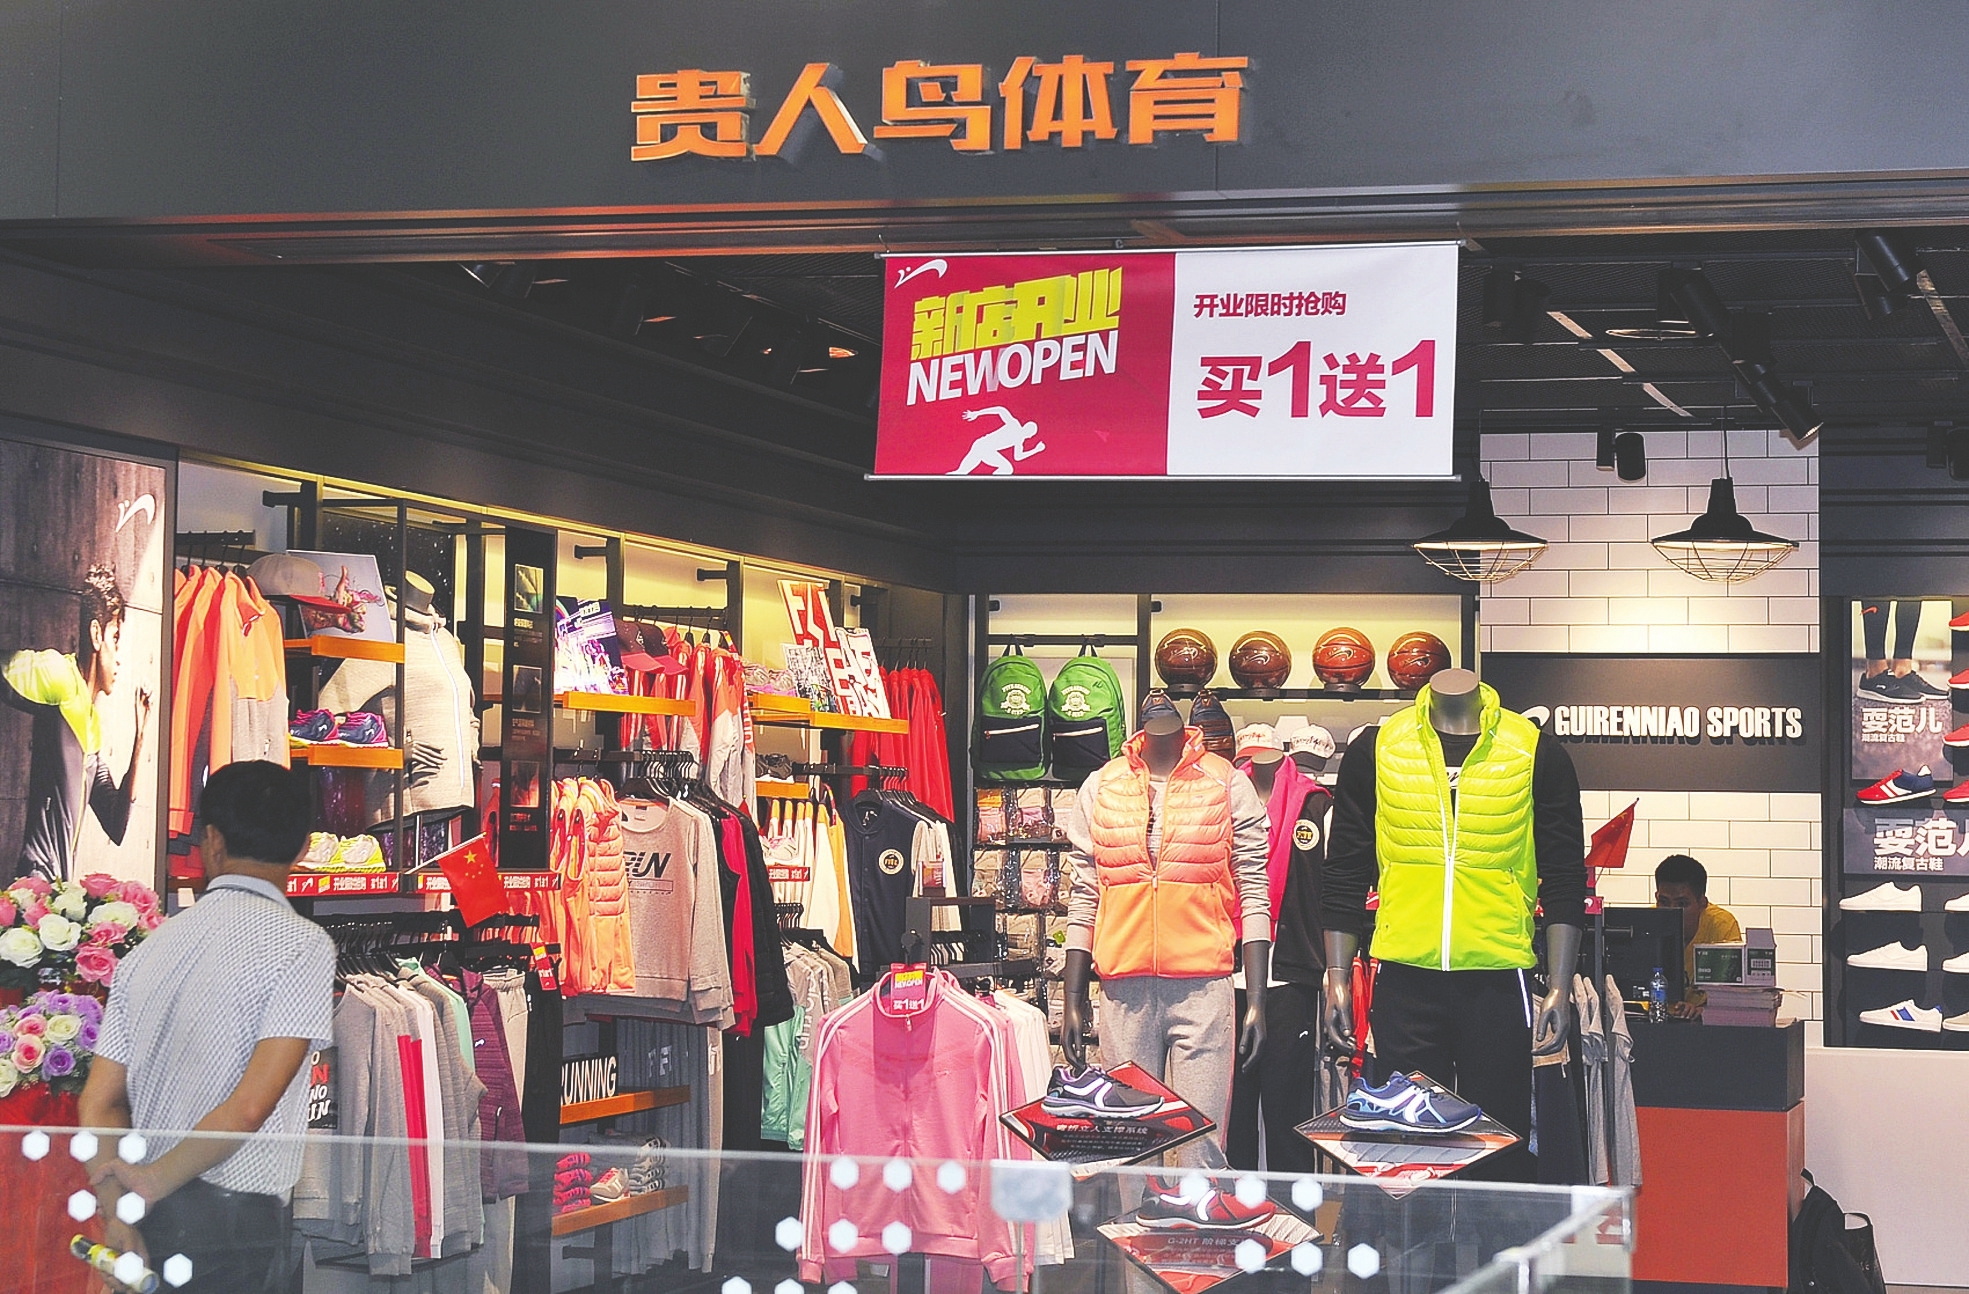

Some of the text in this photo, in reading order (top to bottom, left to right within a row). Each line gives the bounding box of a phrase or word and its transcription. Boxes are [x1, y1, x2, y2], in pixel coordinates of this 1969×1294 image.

[631, 52, 1249, 162] 贵人鸟体育
[910, 266, 1123, 361] 新店开业
[1193, 290, 1347, 318] 开业限时抢购
[1196, 340, 1436, 419] 买1送1
[1554, 705, 1803, 738] GUIRENNIAO SPORTS
[1862, 706, 1943, 733] 耍范儿
[1874, 856, 1944, 871] 潮流复古鞋
